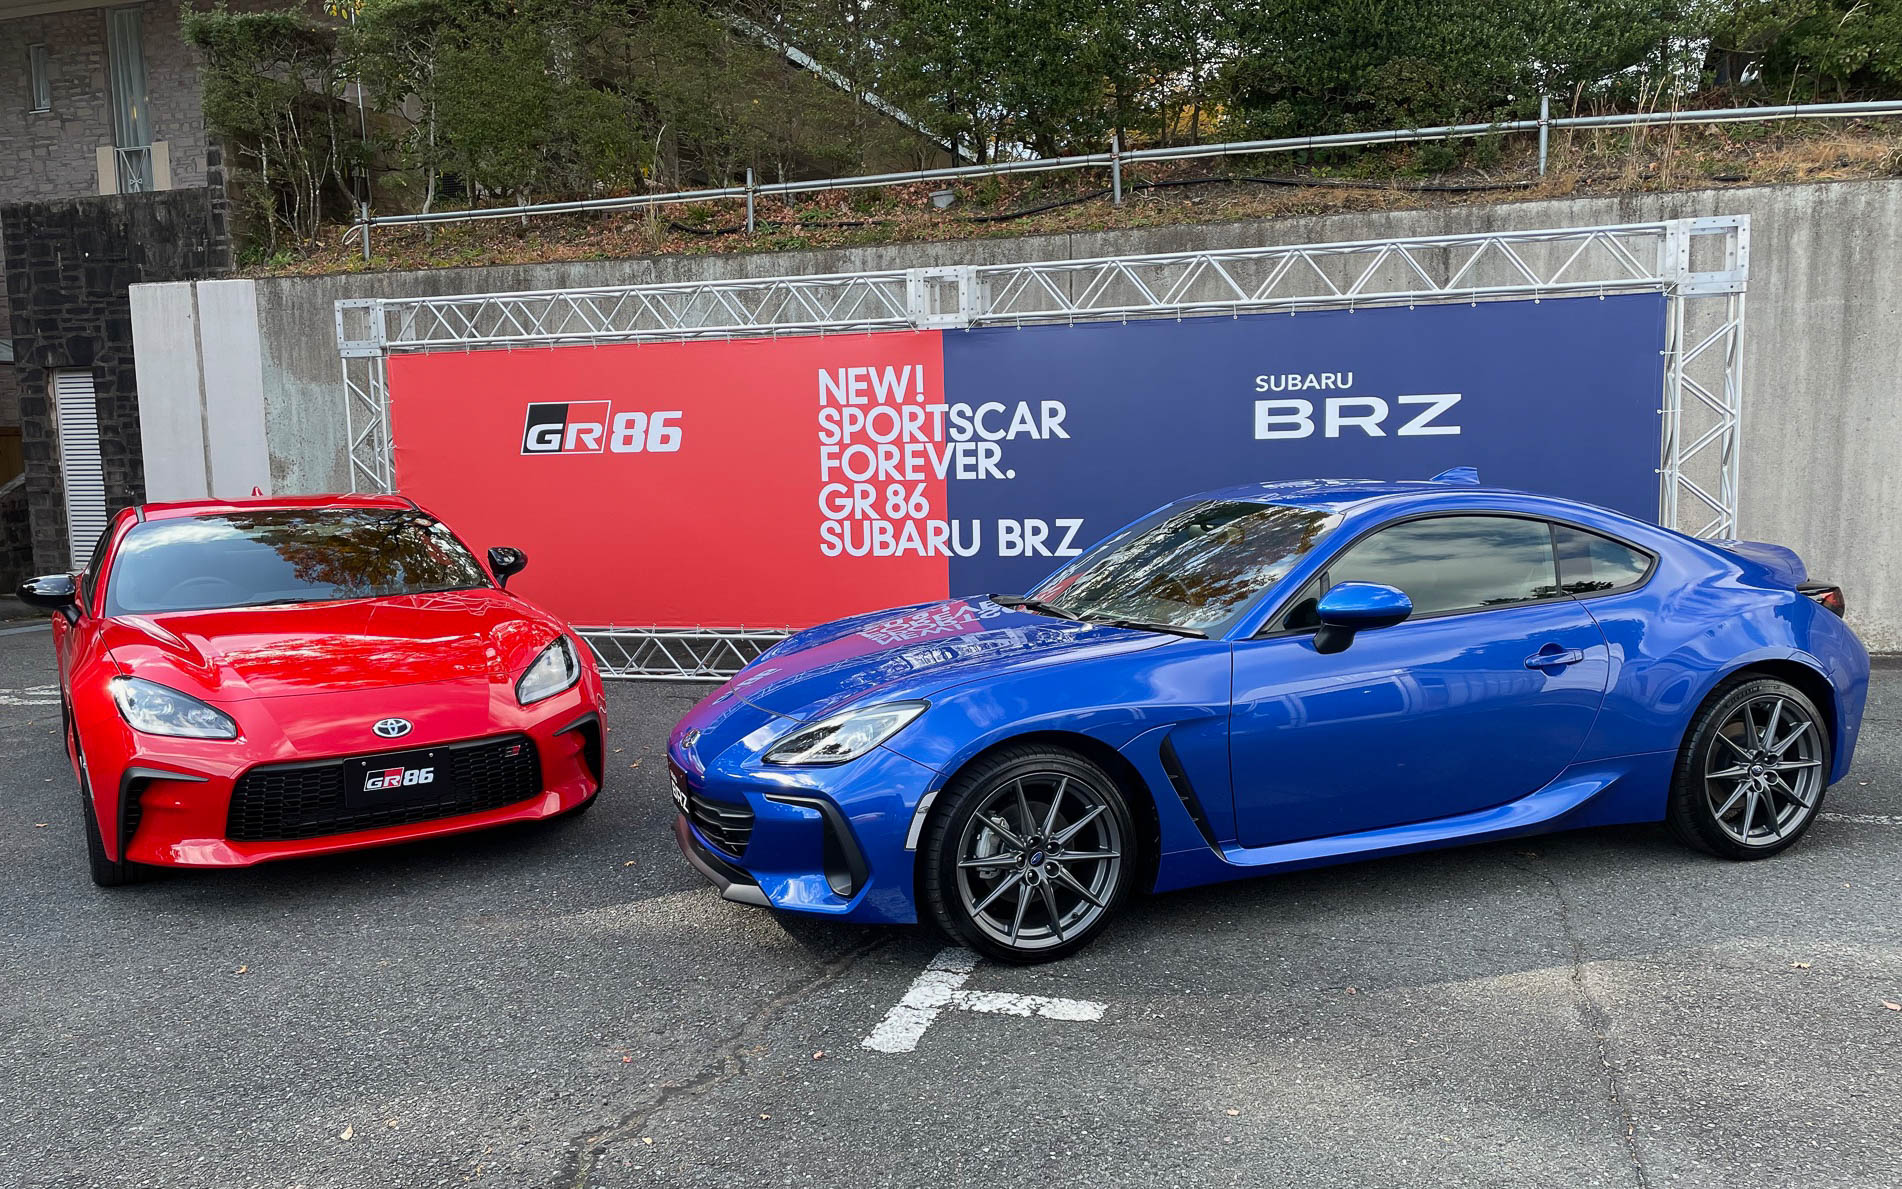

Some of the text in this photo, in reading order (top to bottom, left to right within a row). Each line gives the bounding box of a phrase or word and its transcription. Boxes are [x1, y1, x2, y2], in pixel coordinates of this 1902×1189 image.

[818, 364, 925, 406] NEW!
[1255, 371, 1353, 392] SUBARU
[818, 400, 1071, 444] SPORTSCAR
[1254, 393, 1462, 440] BRZ
[820, 441, 1016, 482] FOREVER.
[820, 518, 1085, 557] SUBARU BRZ
